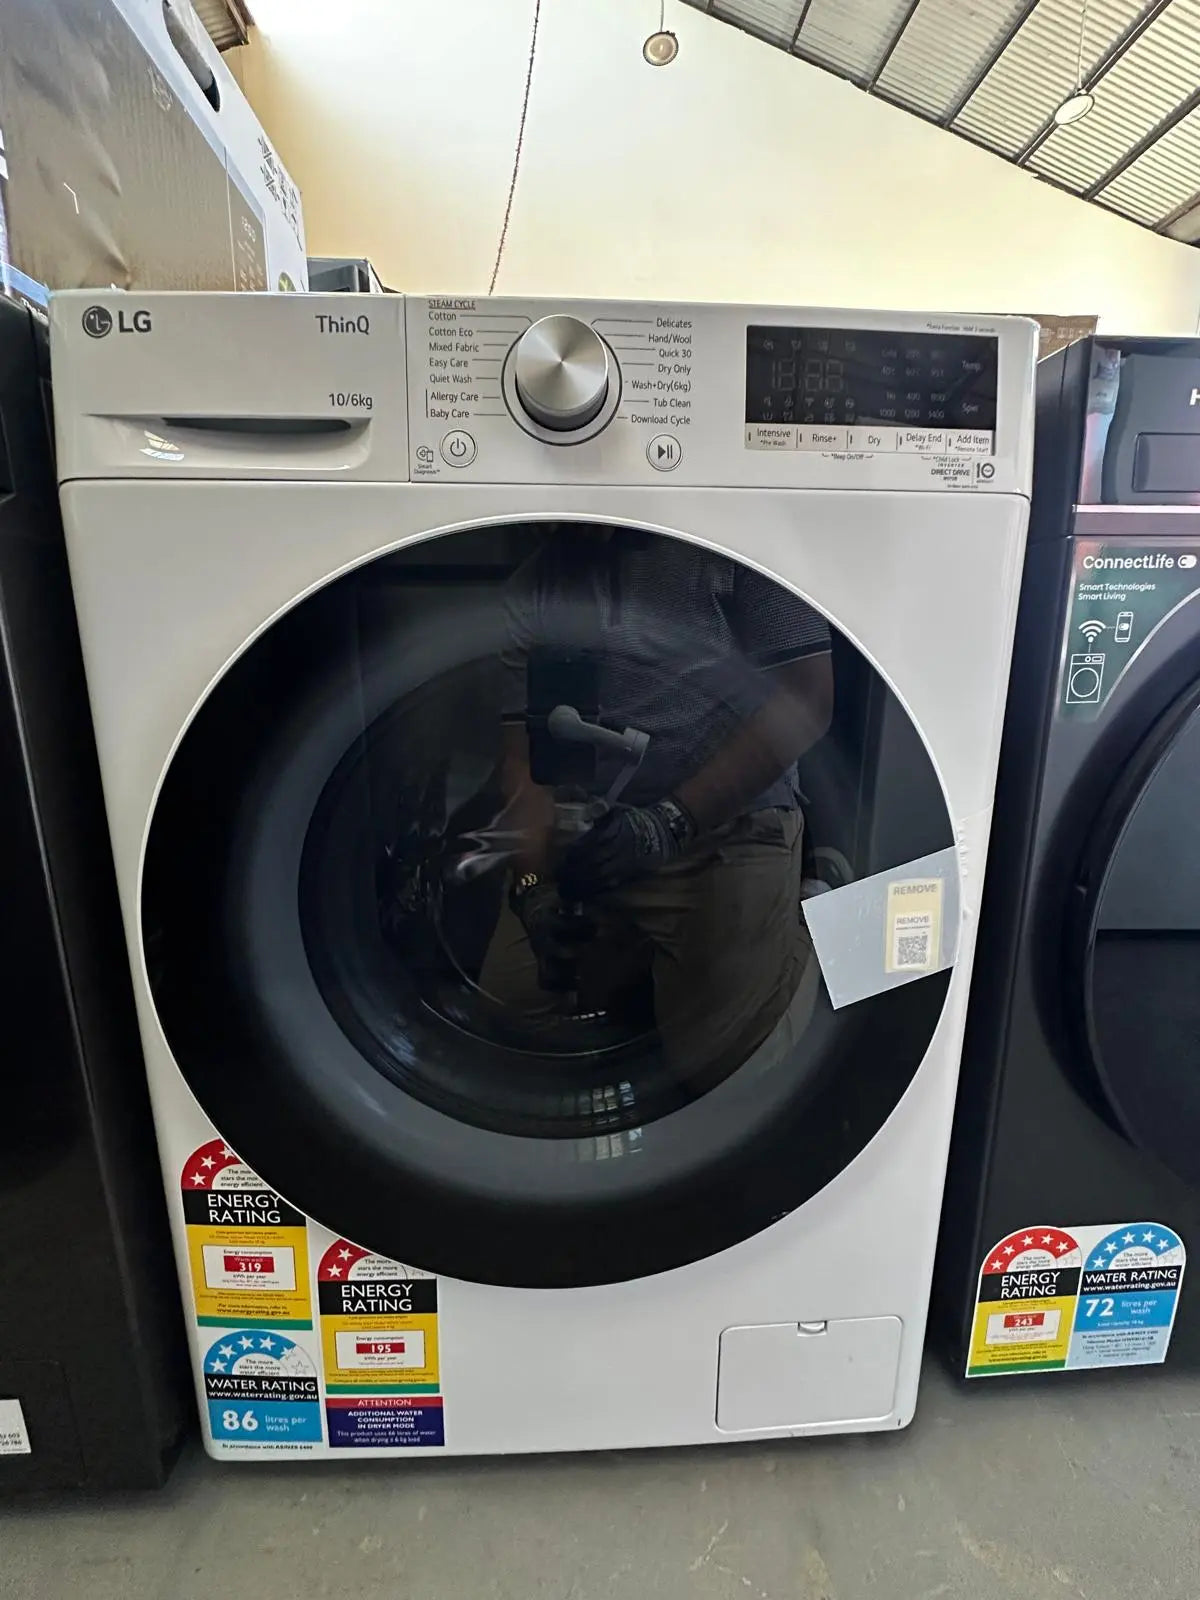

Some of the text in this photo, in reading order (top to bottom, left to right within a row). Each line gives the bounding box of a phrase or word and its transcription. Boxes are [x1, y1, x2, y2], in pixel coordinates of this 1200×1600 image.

[428, 300, 476, 309] STEAM CYCLE
[118, 310, 152, 333] LG
[428, 311, 457, 321] Cotton
[315, 315, 370, 334] ThinQ
[656, 317, 693, 328] Delicates
[428, 327, 474, 337] Cotton Eco
[648, 333, 692, 344] Hand/Wool
[428, 342, 479, 352] Mixed Fabric
[659, 349, 692, 358] Quick 30
[429, 358, 469, 369] Easy Care
[657, 363, 692, 375] Dry Only
[429, 374, 473, 384] Quiet Wash
[631, 380, 692, 392] Wash+Dry(6kg)
[329, 393, 373, 409] 10/6kg
[430, 392, 479, 403] Allergy Care
[653, 398, 691, 408] Tub Clean
[430, 409, 470, 420] Baby Care
[631, 414, 691, 427] Download Cycle
[757, 428, 791, 438] Intensive
[812, 433, 837, 443] Rinse+
[906, 433, 942, 444] Delay End
[868, 435, 881, 446] Dry
[957, 435, 990, 444] Add Item
[930, 468, 970, 477] DIRECT DRIVE
[1082, 555, 1174, 569] ConnectLife
[1079, 582, 1156, 592] Smart Technologies
[1078, 592, 1126, 601] Smart Living
[893, 884, 938, 896] REMOVE
[896, 916, 930, 925] REMOVE
[207, 1193, 281, 1208] ENERGY
[209, 1210, 281, 1223] RATING
[239, 1262, 262, 1271] 319
[1001, 1271, 1060, 1287] ENERGY
[1085, 1269, 1177, 1284] WATER RATING
[341, 1283, 413, 1298] ENERGY
[1001, 1285, 1056, 1299] RATING
[1083, 1281, 1176, 1292] www.waterrating.gov.au
[342, 1298, 412, 1313] RATING
[1085, 1298, 1114, 1318] 72
[1143, 1300, 1157, 1308] per
[1130, 1307, 1151, 1315] wash
[1014, 1318, 1033, 1327] 243
[371, 1344, 392, 1353] 195
[208, 1378, 316, 1392] WATER RATING
[208, 1390, 318, 1400] www.waterrating.gov.au
[222, 1409, 259, 1431] 86
[265, 1415, 307, 1426] litres per
[266, 1424, 290, 1432] wash
